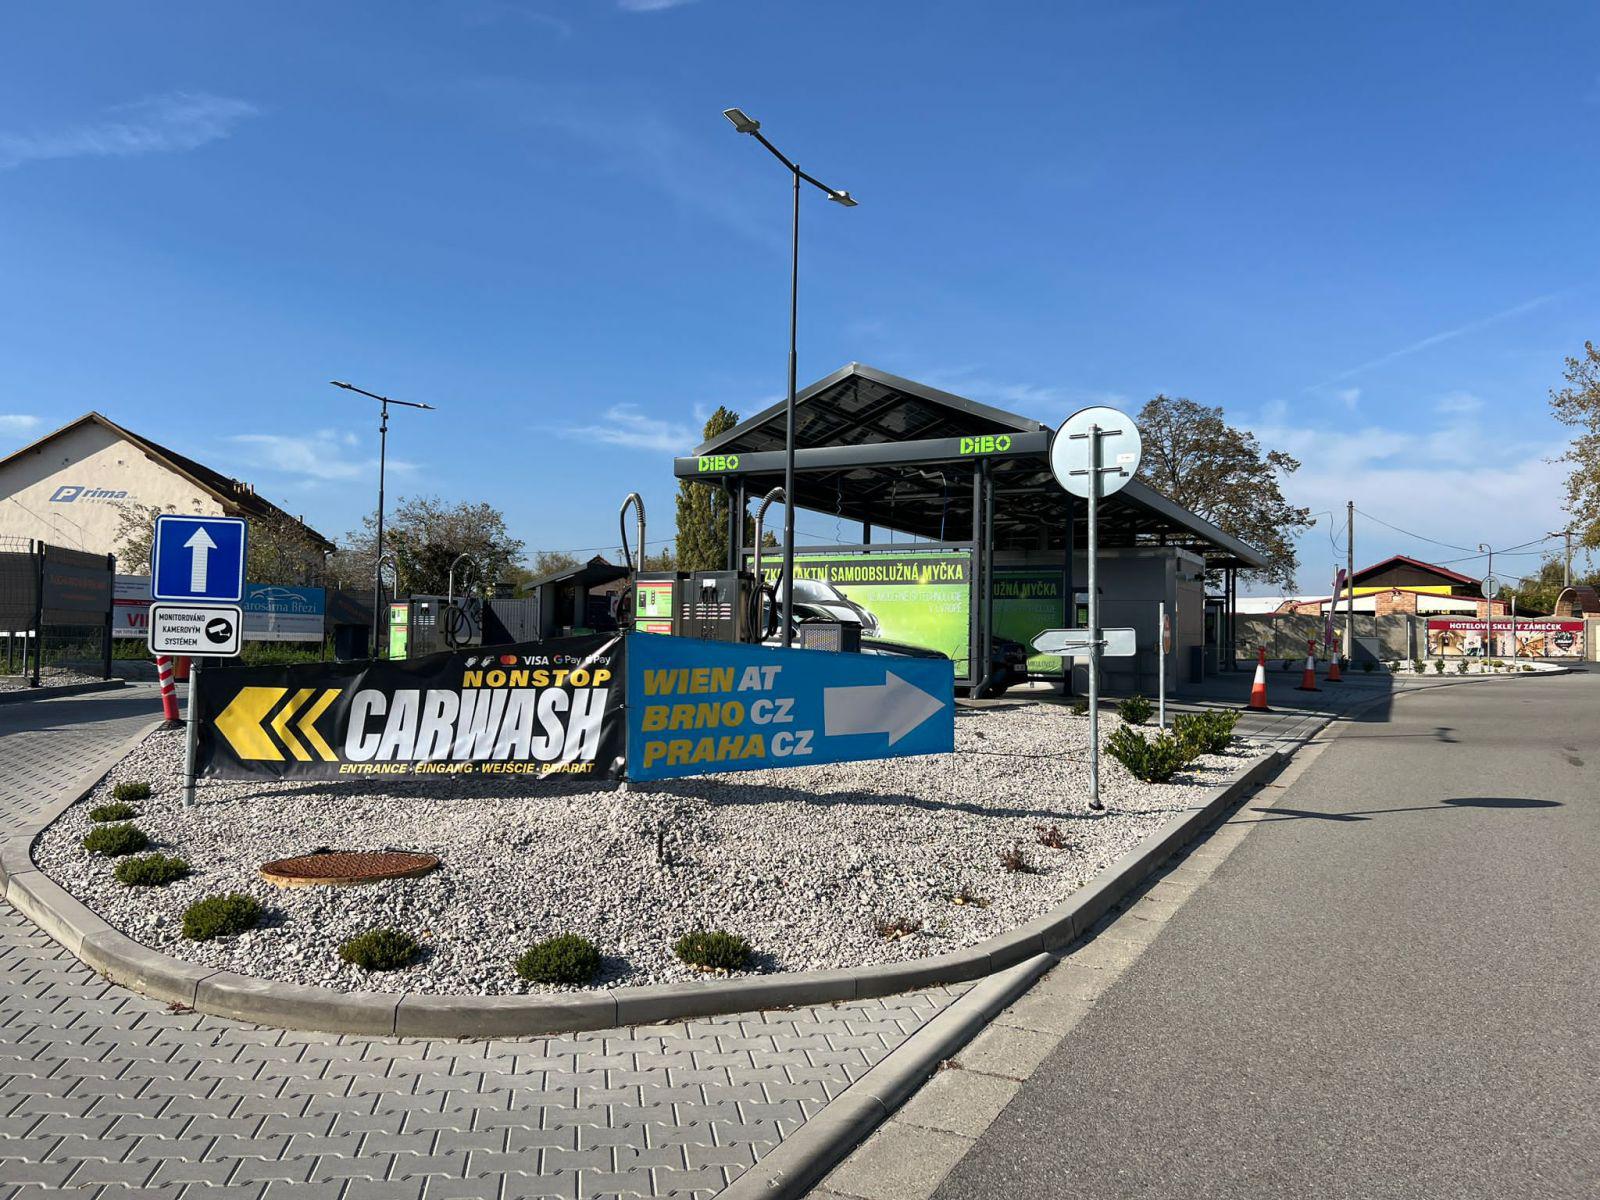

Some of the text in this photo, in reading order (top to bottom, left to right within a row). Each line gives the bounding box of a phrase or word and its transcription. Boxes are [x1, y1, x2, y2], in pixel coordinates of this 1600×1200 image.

[49, 485, 128, 502] Prima
[831, 563, 919, 581] SAMOOBSLUŽNÁ
[922, 561, 964, 580] MYČKA
[1022, 581, 1057, 596] MYČKA
[159, 613, 206, 622] MONITOROVÁNO
[162, 625, 201, 634] KAMEROVÝM
[1523, 622, 1562, 630] ZÁMEČEK
[164, 637, 198, 646] SYSTÉMEM
[522, 655, 549, 665] VISA
[462, 669, 612, 688] NONSTOP
[643, 665, 782, 696] WIEN AT
[641, 698, 795, 732] BRNO CZ
[344, 688, 609, 762] CARWASH
[643, 730, 815, 768] PRAHA CZ
[339, 763, 408, 774] ENTRANCE
[415, 763, 473, 774] EINGANG
[481, 761, 534, 774] WEJŚCIE
